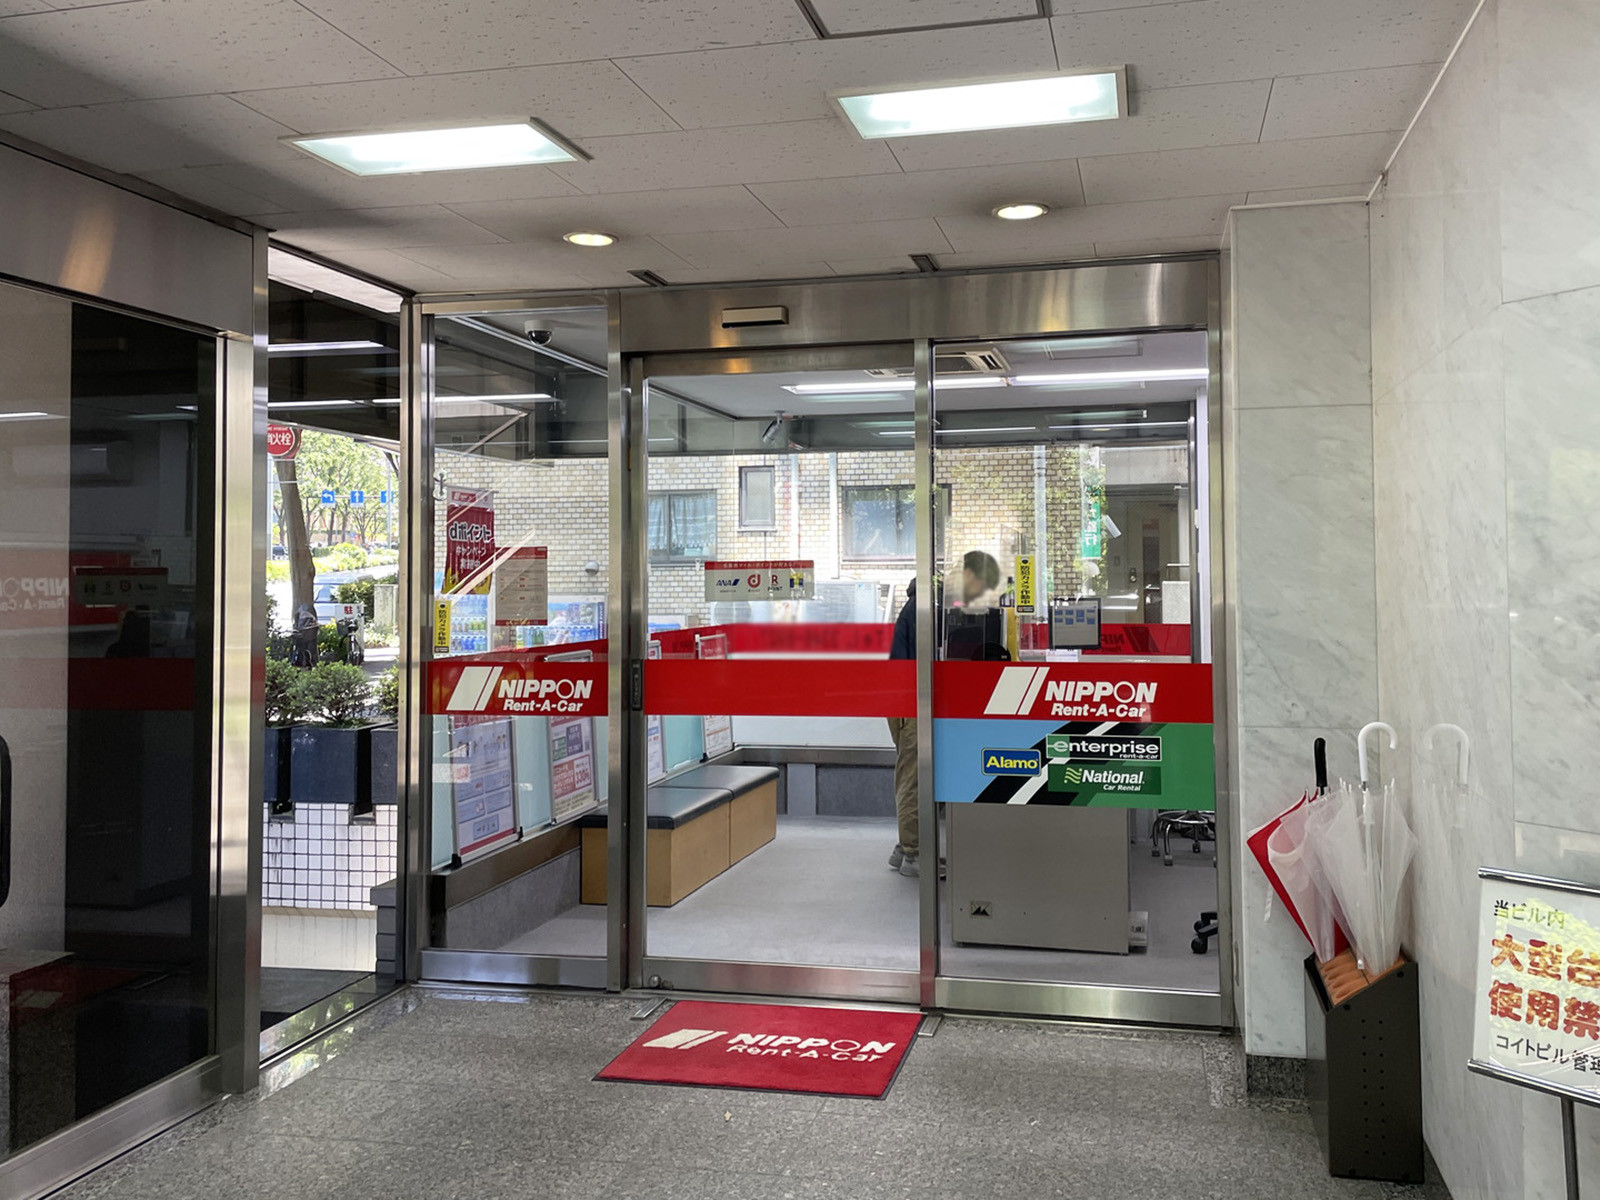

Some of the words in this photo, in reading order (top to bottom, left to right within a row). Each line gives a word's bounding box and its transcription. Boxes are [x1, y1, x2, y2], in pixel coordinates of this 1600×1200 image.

[450, 522, 492, 542] dポイント
[716, 579, 732, 587] ANA
[771, 574, 779, 584] R
[1020, 565, 1031, 604] 防犯カメラ作動中
[498, 679, 593, 699] NIPPON
[1044, 681, 1158, 703] NIPPON
[503, 699, 583, 713] Rent-A-Car
[1050, 702, 1146, 718] Rent-A-Car
[1053, 740, 1160, 757] enterprise
[986, 755, 1038, 770] Alamo
[1082, 769, 1144, 785] National
[1117, 784, 1141, 792] Rental
[1493, 899, 1565, 929] 当ビル内
[1491, 934, 1600, 989] 大型台
[1489, 979, 1600, 1041] 使用禁
[727, 1033, 896, 1054] NIPPON
[726, 1044, 885, 1062] Rent-A-Car
